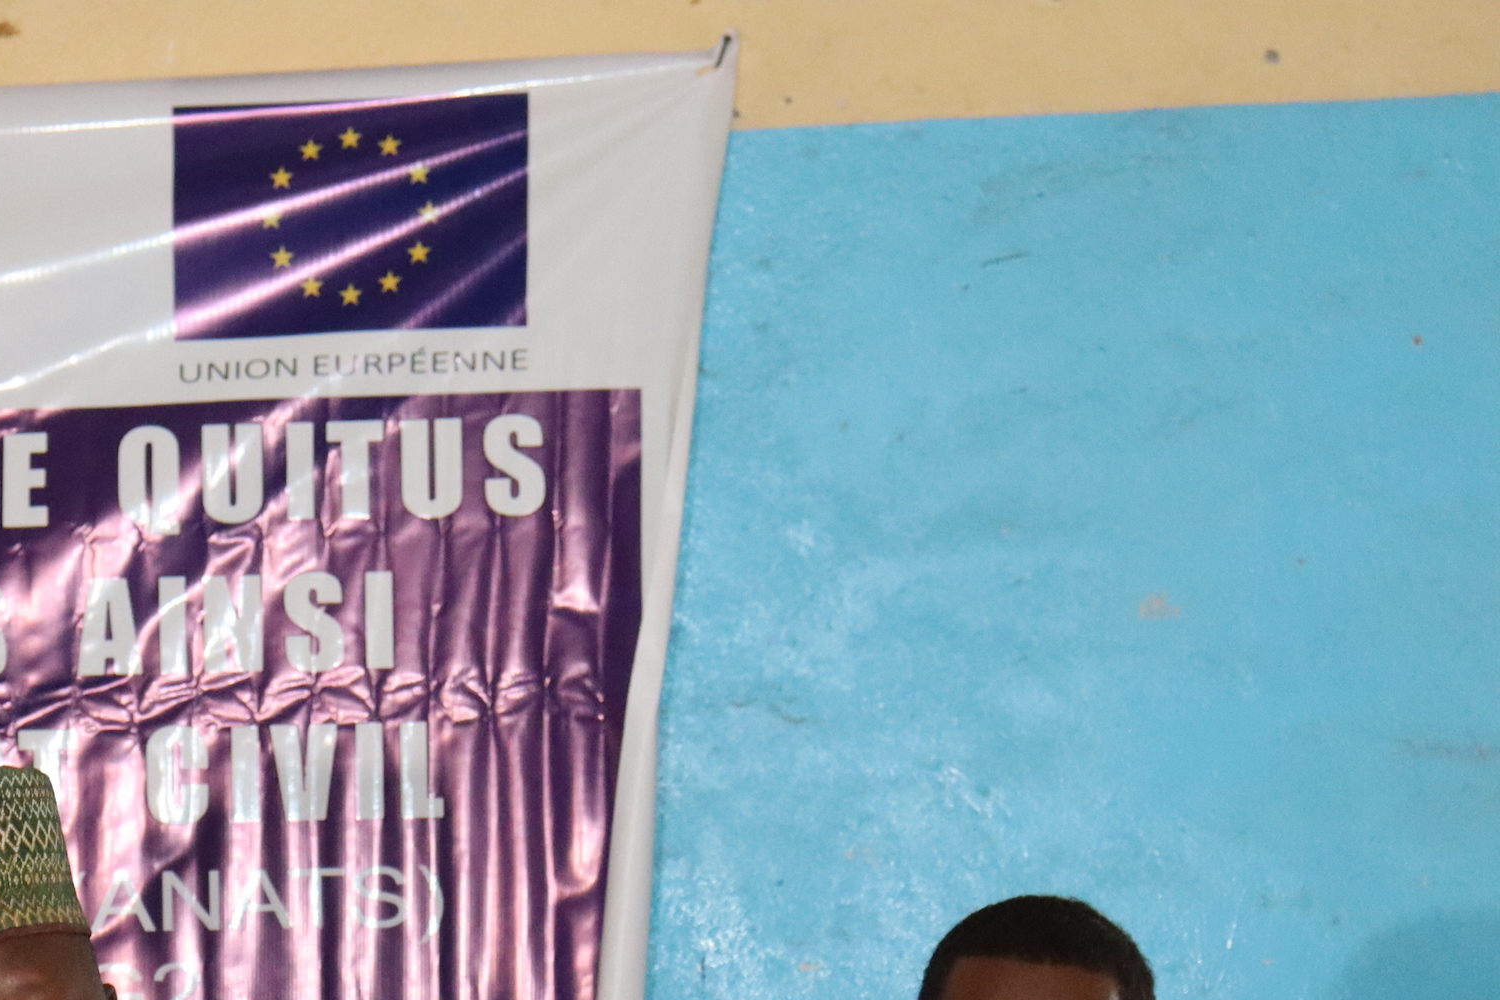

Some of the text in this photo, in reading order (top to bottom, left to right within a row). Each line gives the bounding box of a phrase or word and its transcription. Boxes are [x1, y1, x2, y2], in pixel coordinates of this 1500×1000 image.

[178, 346, 531, 384] UNION EURPÉENNE
[116, 413, 547, 534] QUITUS
[77, 570, 396, 676] AINSI
[146, 720, 444, 826] CIVIL
[74, 862, 446, 944] ANATS)
